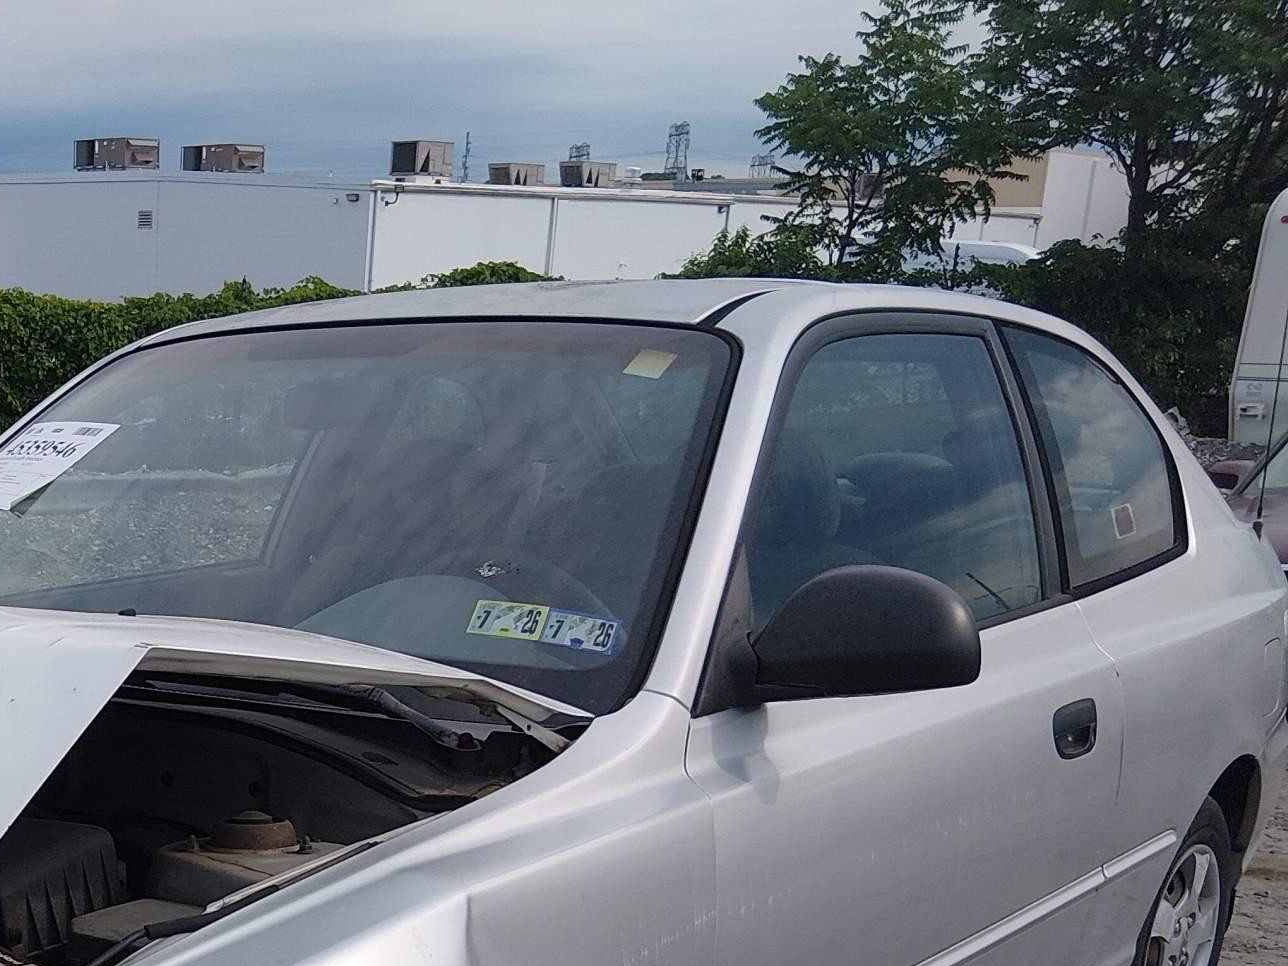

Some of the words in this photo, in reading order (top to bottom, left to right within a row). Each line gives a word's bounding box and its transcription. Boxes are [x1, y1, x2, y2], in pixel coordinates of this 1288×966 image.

[6, 440, 85, 458] 45359546
[520, 609, 542, 634] 26
[593, 622, 614, 648] 26
